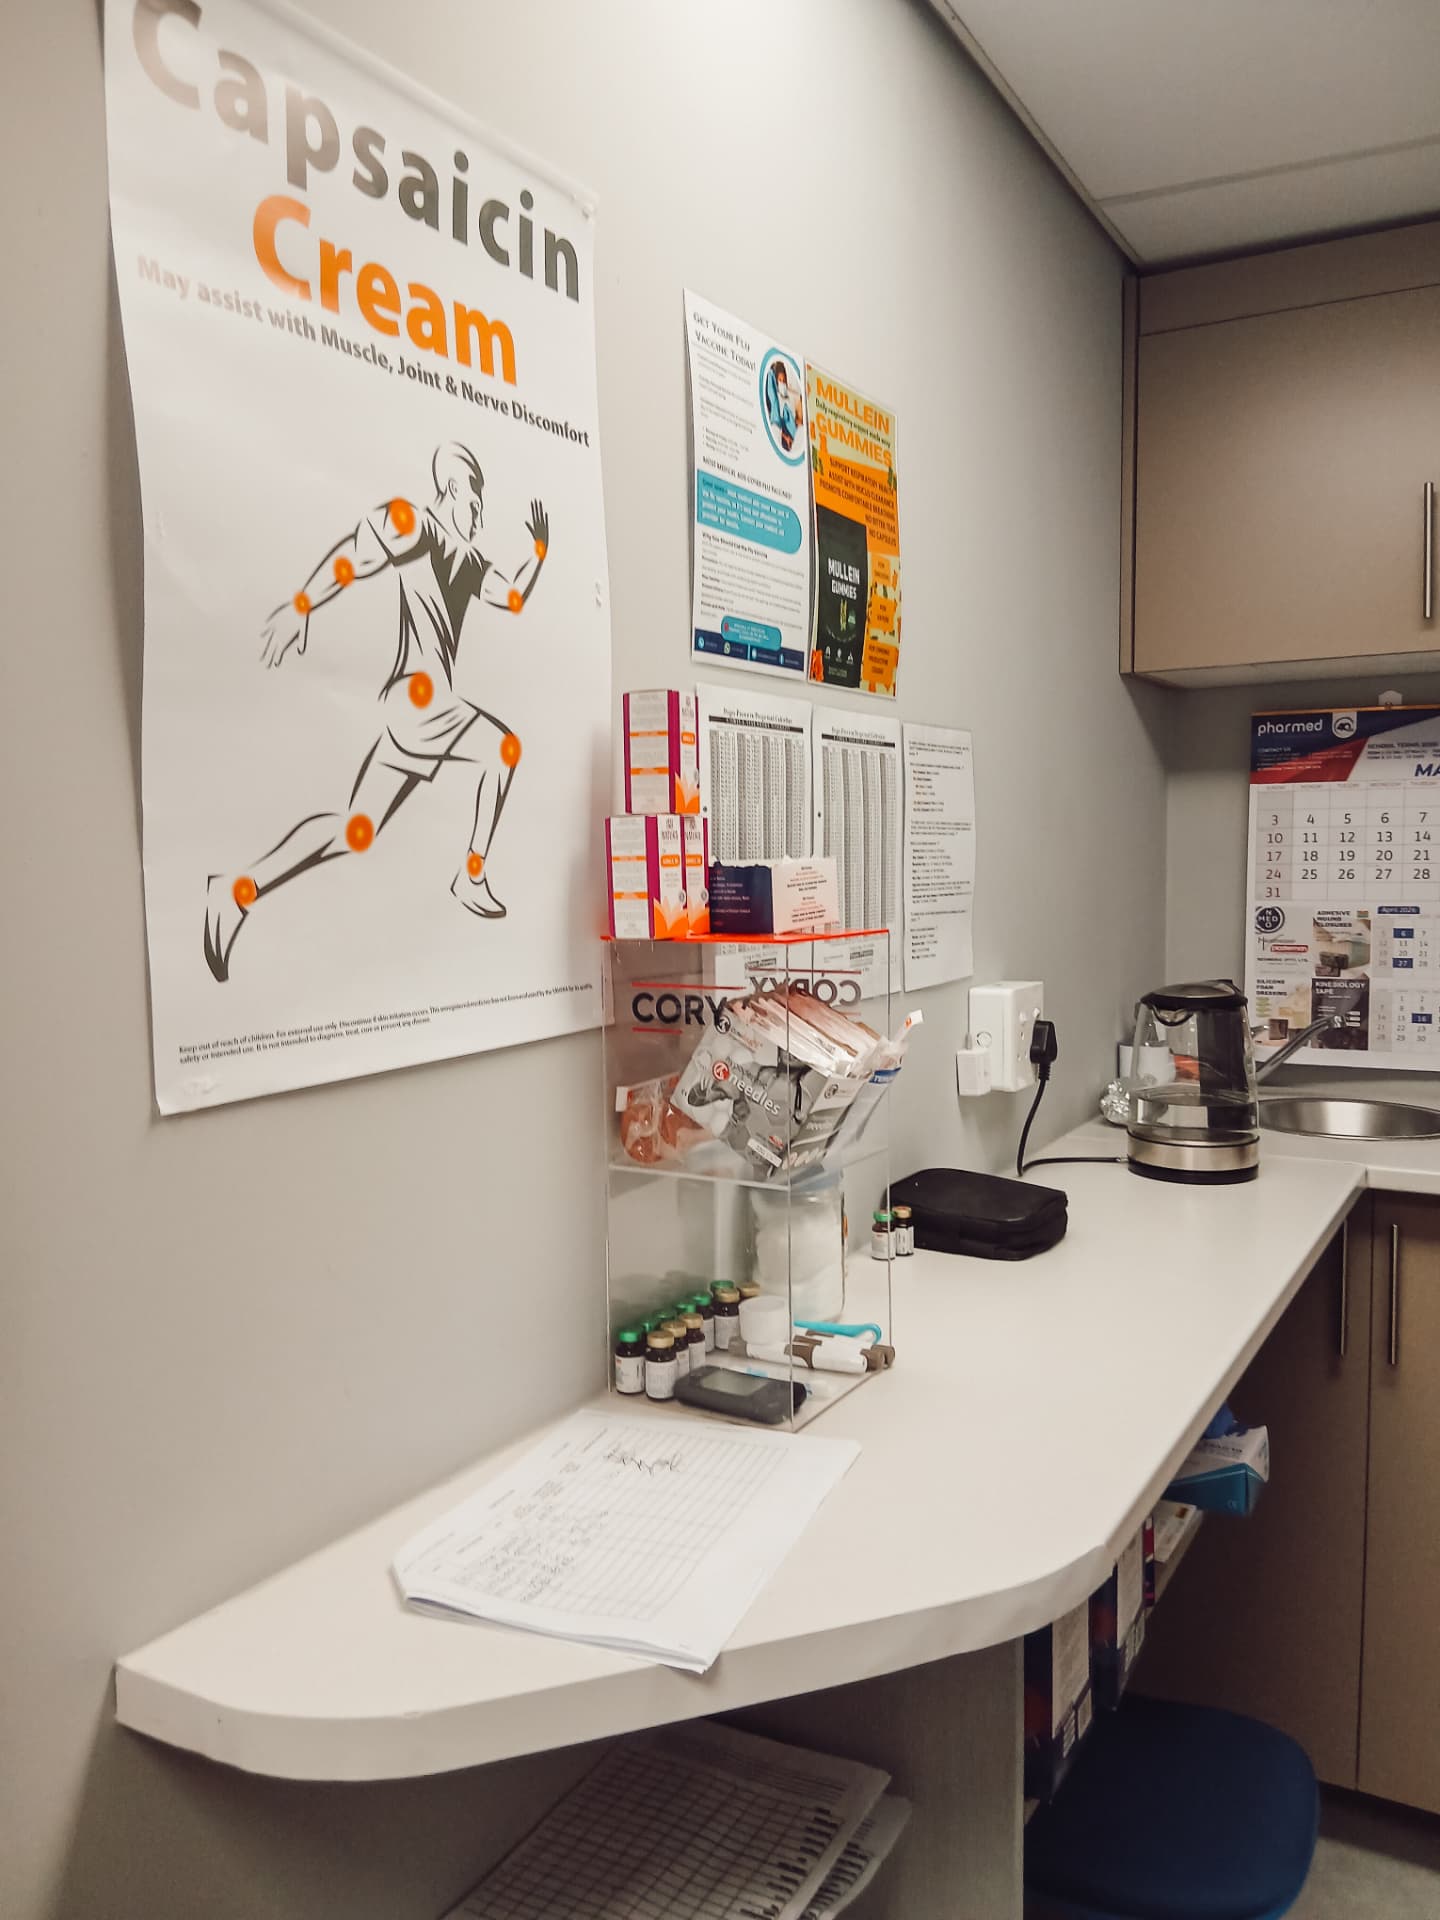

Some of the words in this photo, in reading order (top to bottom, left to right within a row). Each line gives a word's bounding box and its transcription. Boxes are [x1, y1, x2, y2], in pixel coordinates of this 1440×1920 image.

[133, 0, 579, 304] Capsaicin
[253, 195, 518, 386] Cream
[137, 254, 190, 300] May
[197, 281, 264, 323] assist
[267, 307, 316, 341] with
[321, 324, 394, 374] Muscle,
[397, 356, 442, 391] Joint
[445, 374, 458, 397] &
[461, 380, 509, 416] Nerve
[511, 400, 589, 448] Discomfort
[816, 377, 890, 436] MULLEIN
[815, 412, 893, 468] GUMMIES
[828, 557, 860, 585] MULLEIN
[831, 579, 857, 600] GUMMIES
[1257, 718, 1323, 737] pharmed
[1272, 815, 1278, 826] 3
[1307, 814, 1315, 824] 4
[1344, 814, 1352, 824] 5
[1381, 812, 1390, 823] 6
[1419, 812, 1427, 822] 7
[1267, 832, 1283, 844] 10
[1303, 833, 1318, 842] 11
[1340, 832, 1355, 842] 12
[1377, 832, 1392, 842] 13
[1415, 831, 1431, 842] 14
[1266, 852, 1282, 862] 17
[1303, 851, 1318, 861] 18
[1339, 850, 1355, 861] 19
[1376, 850, 1392, 860] 20
[1413, 850, 1430, 860] 21
[1266, 870, 1281, 880] 24
[1302, 869, 1318, 880] 25
[1338, 869, 1355, 880] 26
[1376, 868, 1392, 879] 27
[1413, 868, 1430, 880] 28
[1265, 887, 1280, 898] 31
[631, 991, 748, 1026] CORY
[728, 1071, 781, 1115] needles
